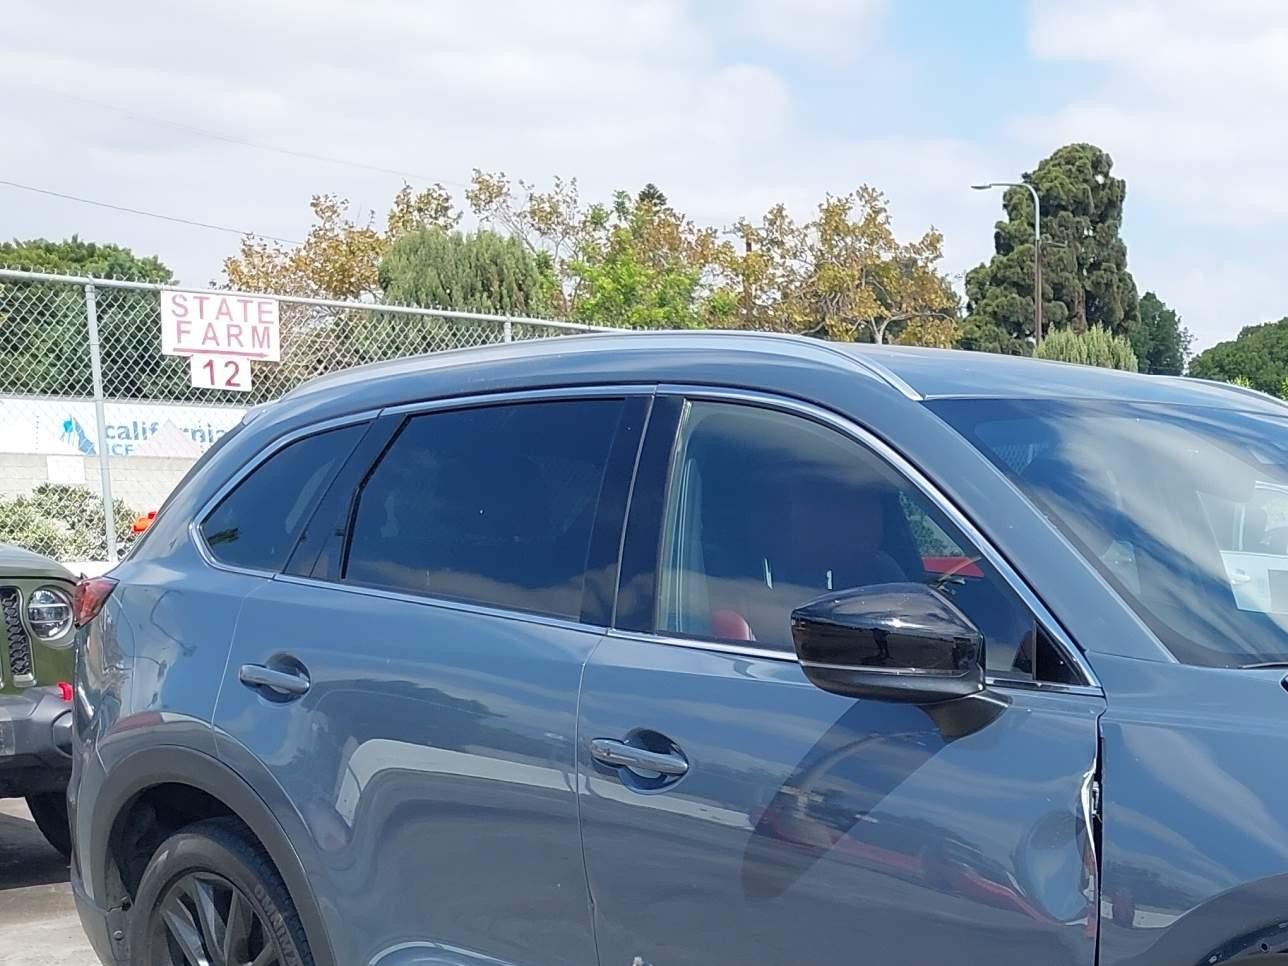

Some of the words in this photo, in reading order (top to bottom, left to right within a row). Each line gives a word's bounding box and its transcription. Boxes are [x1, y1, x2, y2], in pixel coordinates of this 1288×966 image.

[171, 294, 275, 325] STATE
[176, 320, 271, 349] FARM
[203, 359, 241, 387] 12
